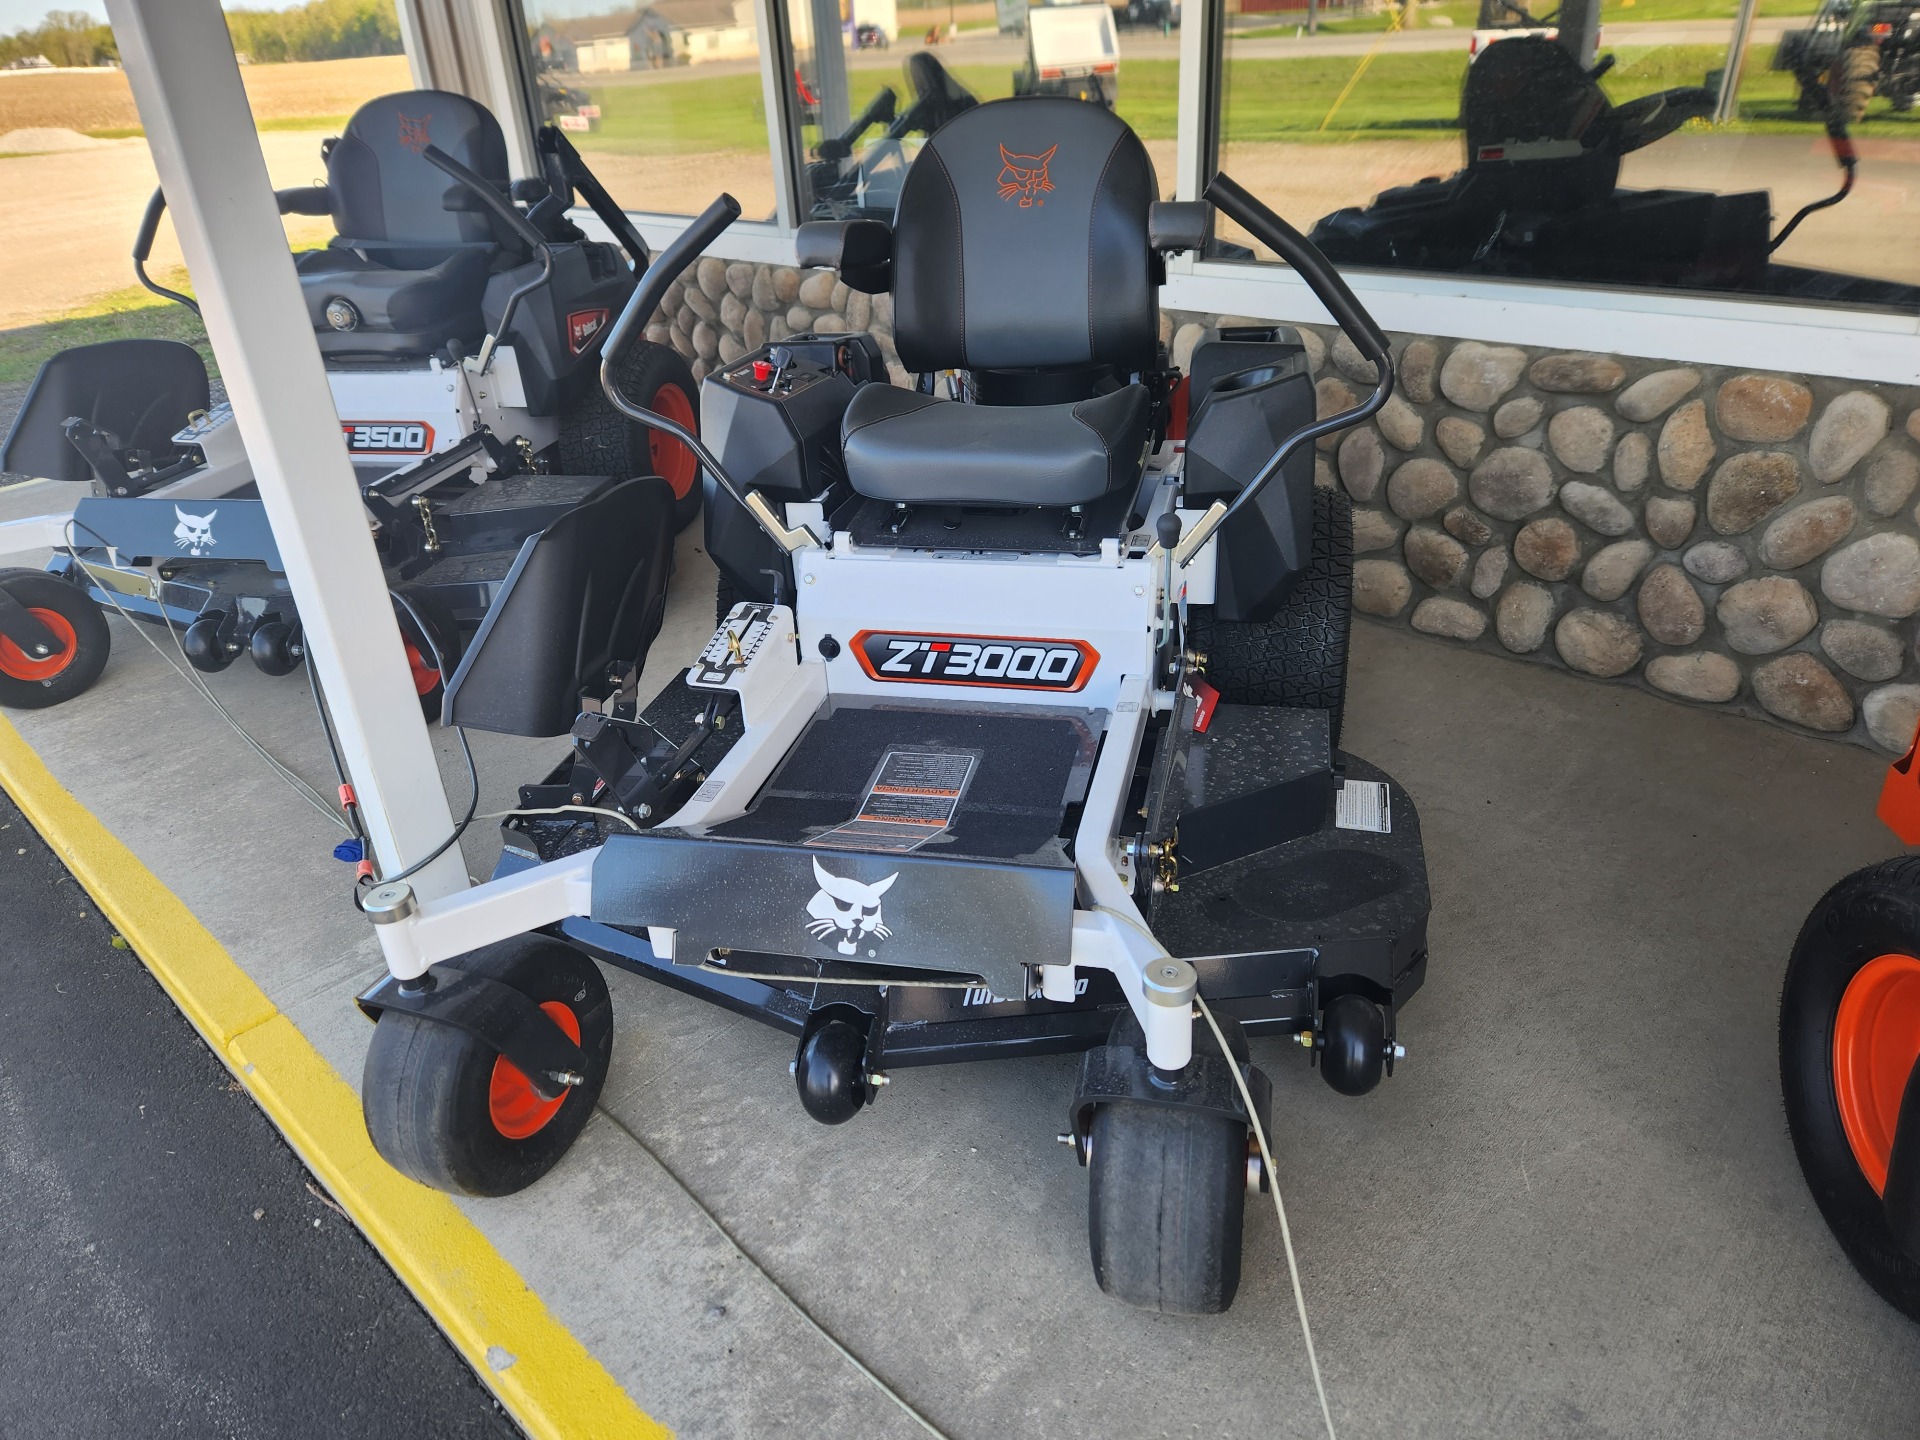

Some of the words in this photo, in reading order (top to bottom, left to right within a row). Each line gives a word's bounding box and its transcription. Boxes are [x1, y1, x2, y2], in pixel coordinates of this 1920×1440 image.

[880, 640, 1080, 682] ZT3000
[876, 785, 945, 795] ADVERTENCIA
[873, 816, 921, 824] WARNING
